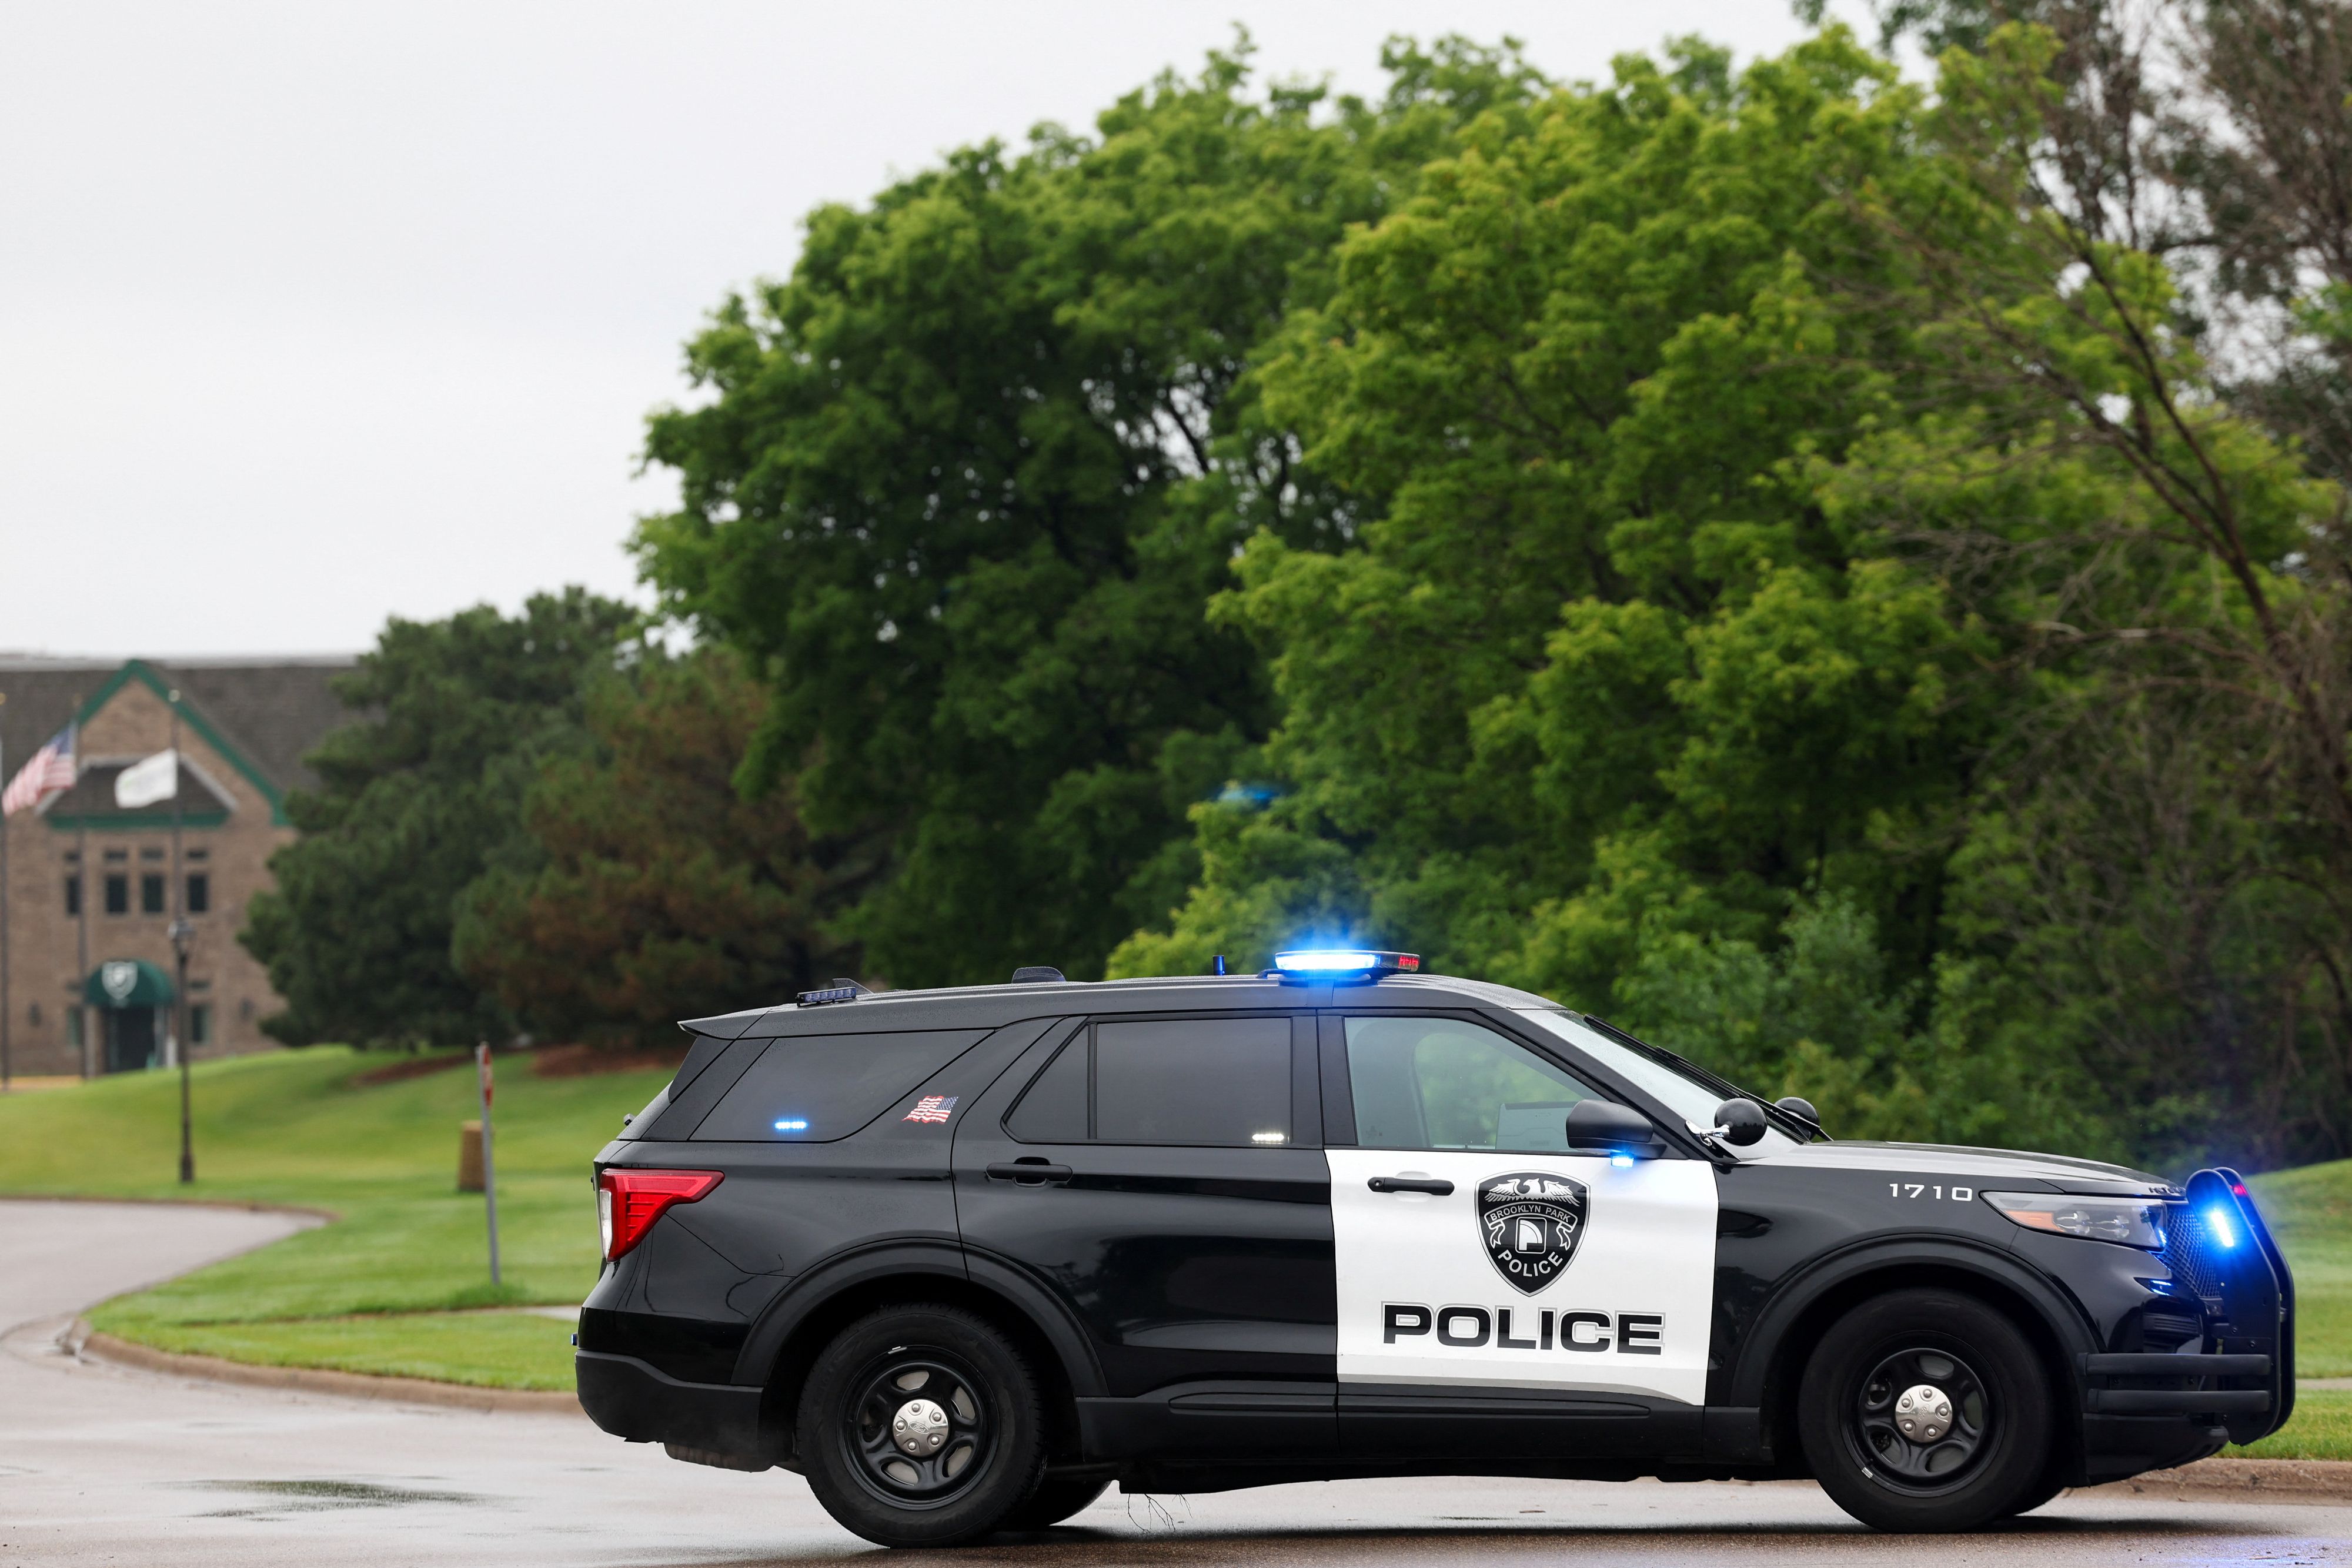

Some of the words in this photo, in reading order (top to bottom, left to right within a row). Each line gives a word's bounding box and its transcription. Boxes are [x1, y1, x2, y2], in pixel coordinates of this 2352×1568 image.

[1889, 1183, 1973, 1202] 1710
[1490, 1205, 1541, 1221] BROOKLYN
[1545, 1207, 1571, 1222] PARK
[1498, 1249, 1563, 1277] POLICE
[1381, 1301, 1666, 1355] POLICE
